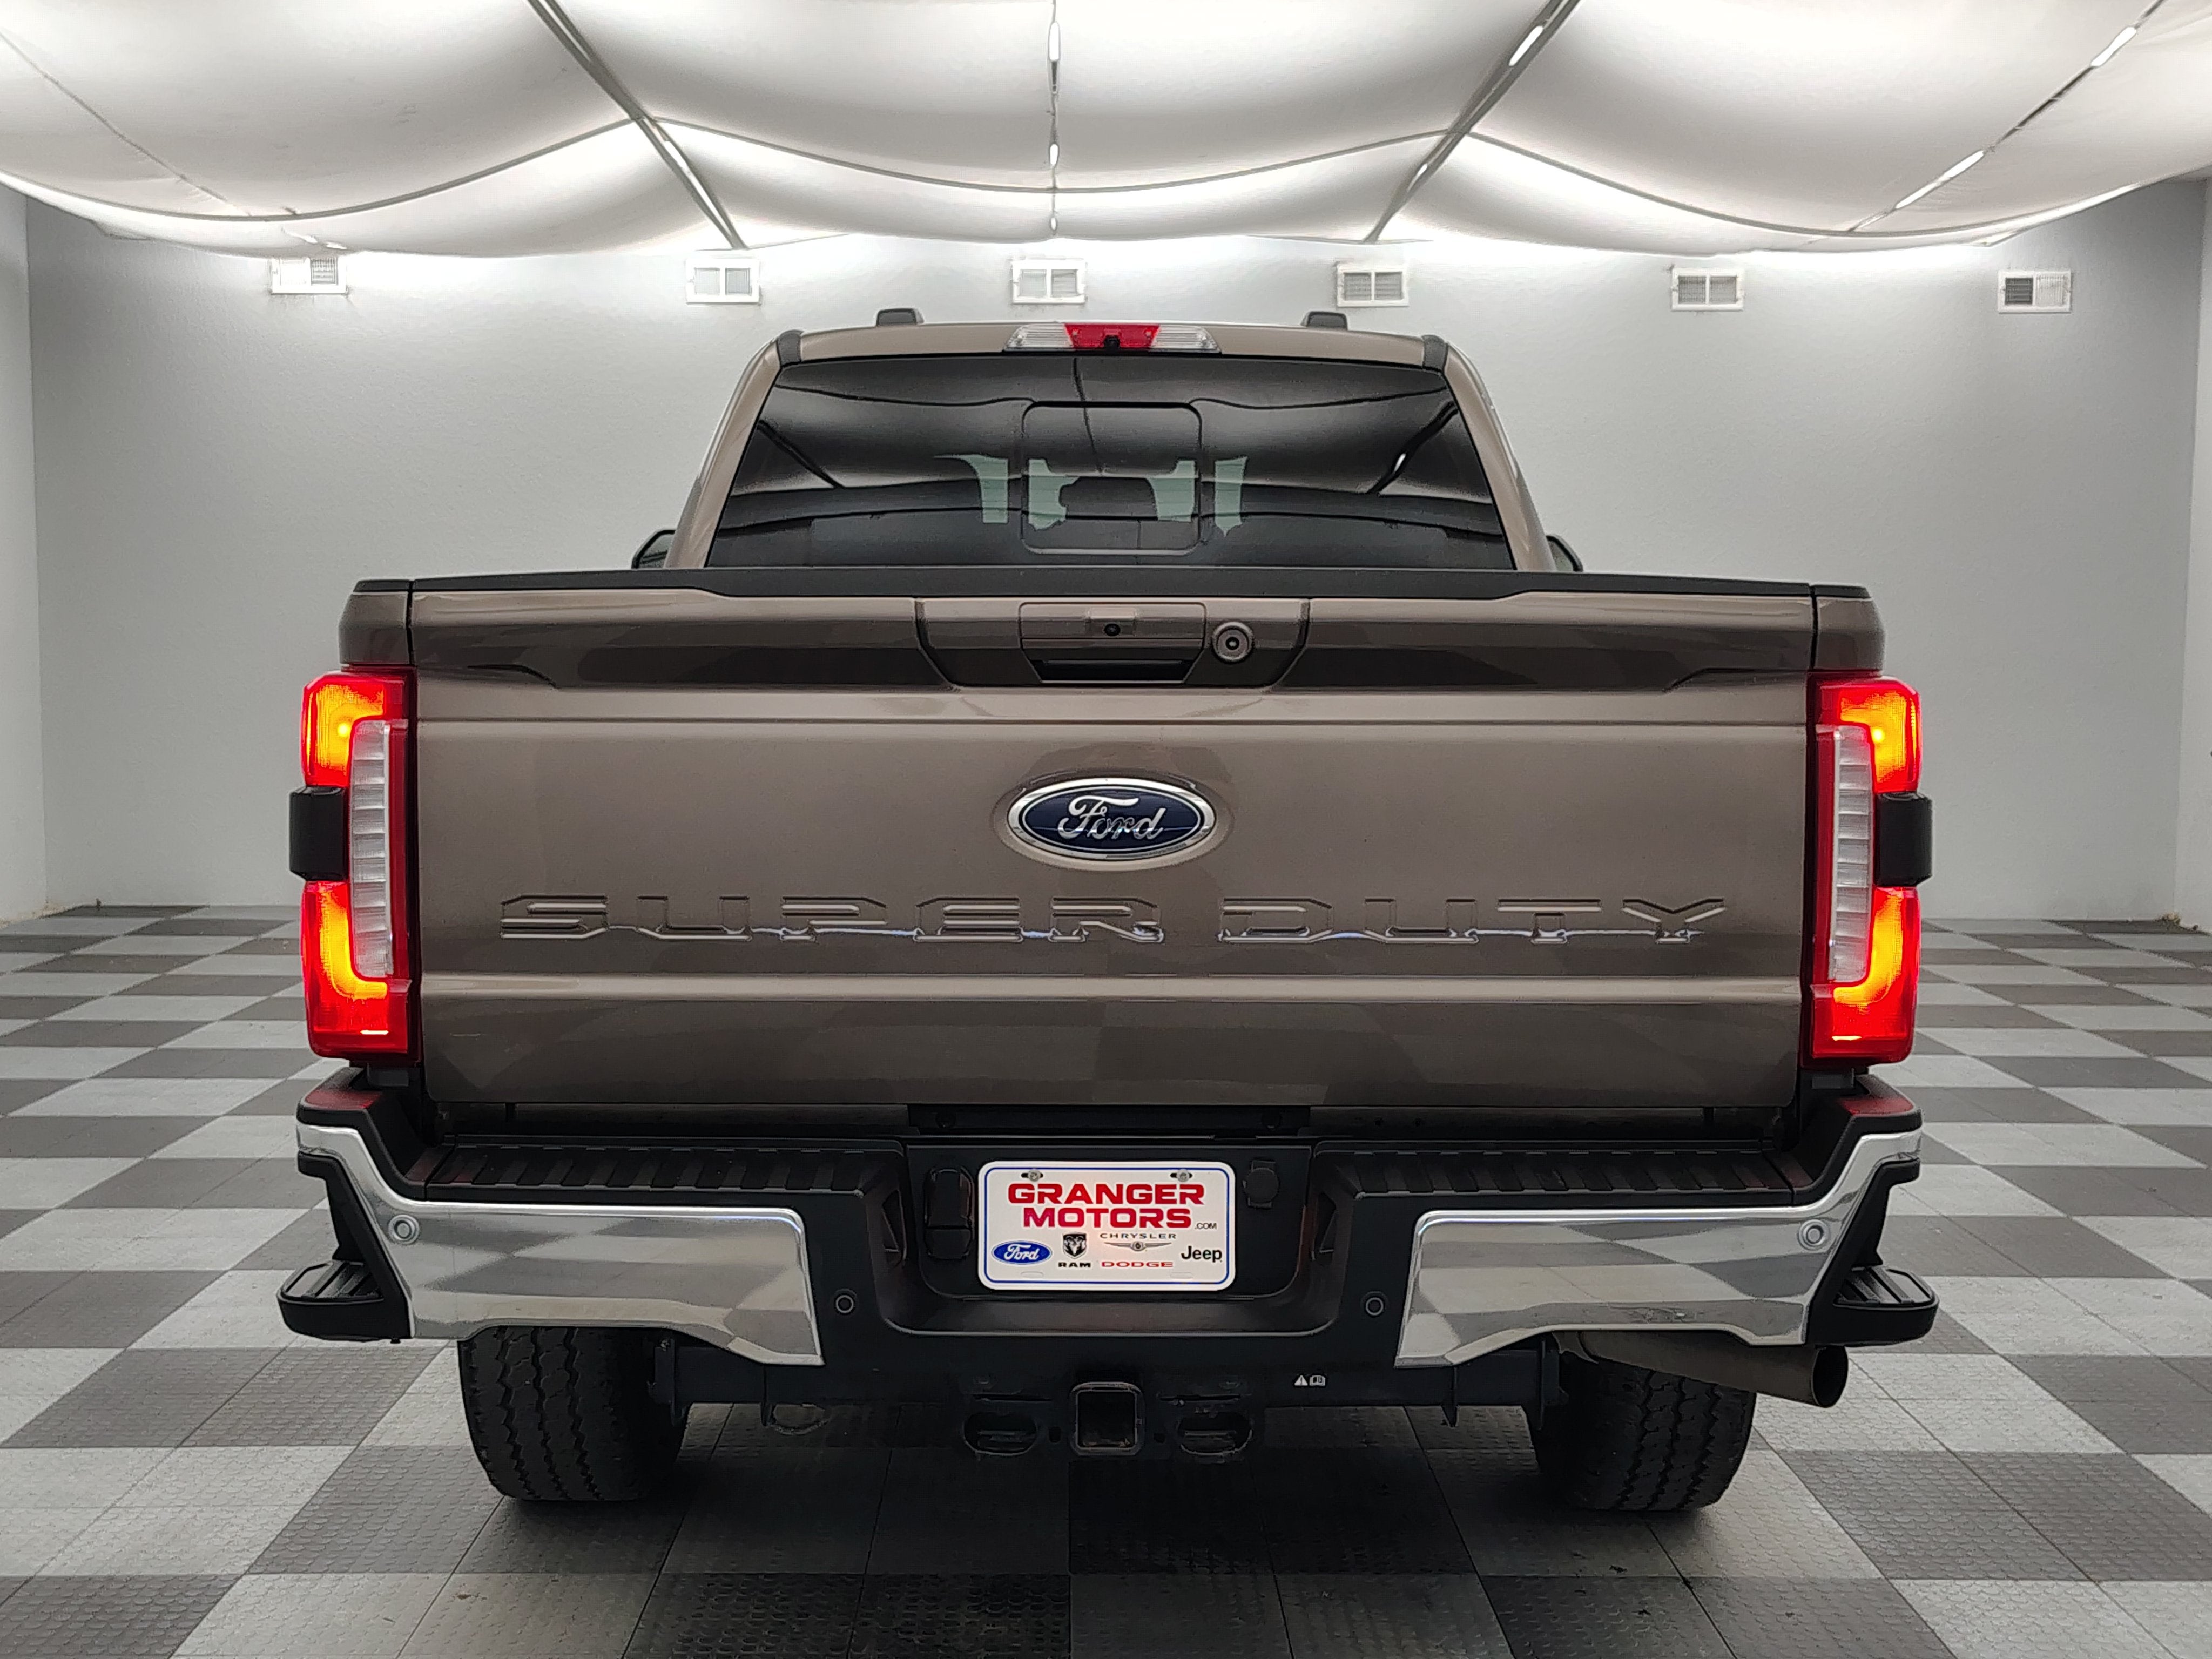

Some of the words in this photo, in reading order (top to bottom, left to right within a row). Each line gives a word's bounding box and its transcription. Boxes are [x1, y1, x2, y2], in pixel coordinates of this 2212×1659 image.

[1057, 795, 1166, 840] Ford
[500, 895, 1165, 943] SUPER
[1218, 896, 1725, 944] DUTY
[1008, 1183, 1205, 1205] GRANGER
[1023, 1207, 1192, 1229] MOTORS
[1003, 1244, 1040, 1260] Ford
[1181, 1245, 1223, 1263] Jeep
